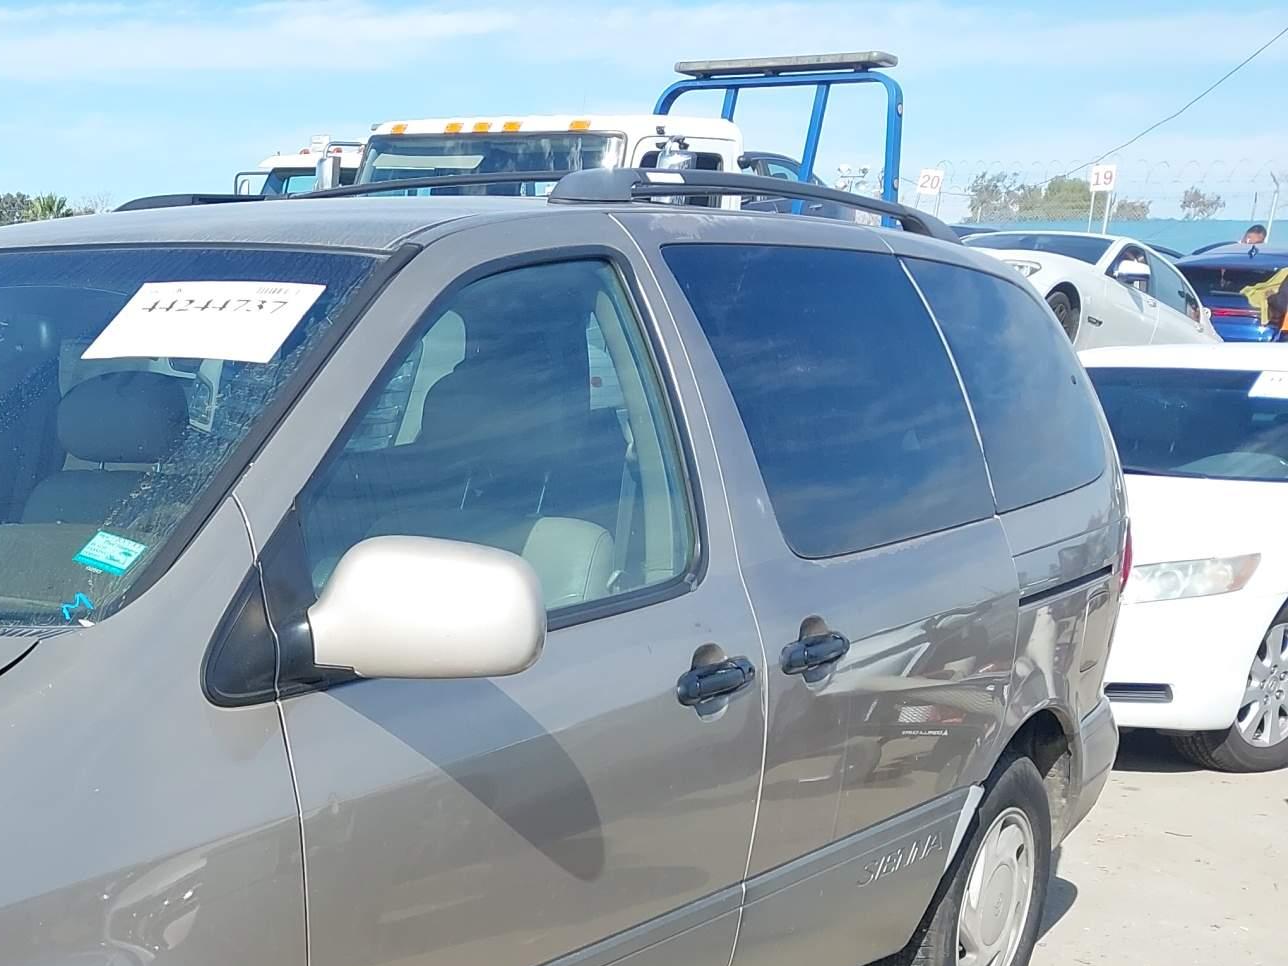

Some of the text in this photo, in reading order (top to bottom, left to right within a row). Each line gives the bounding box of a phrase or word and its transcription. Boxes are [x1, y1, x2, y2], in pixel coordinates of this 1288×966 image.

[919, 174, 941, 190] 20
[1092, 169, 1114, 186] 19
[141, 298, 289, 314] 44244737
